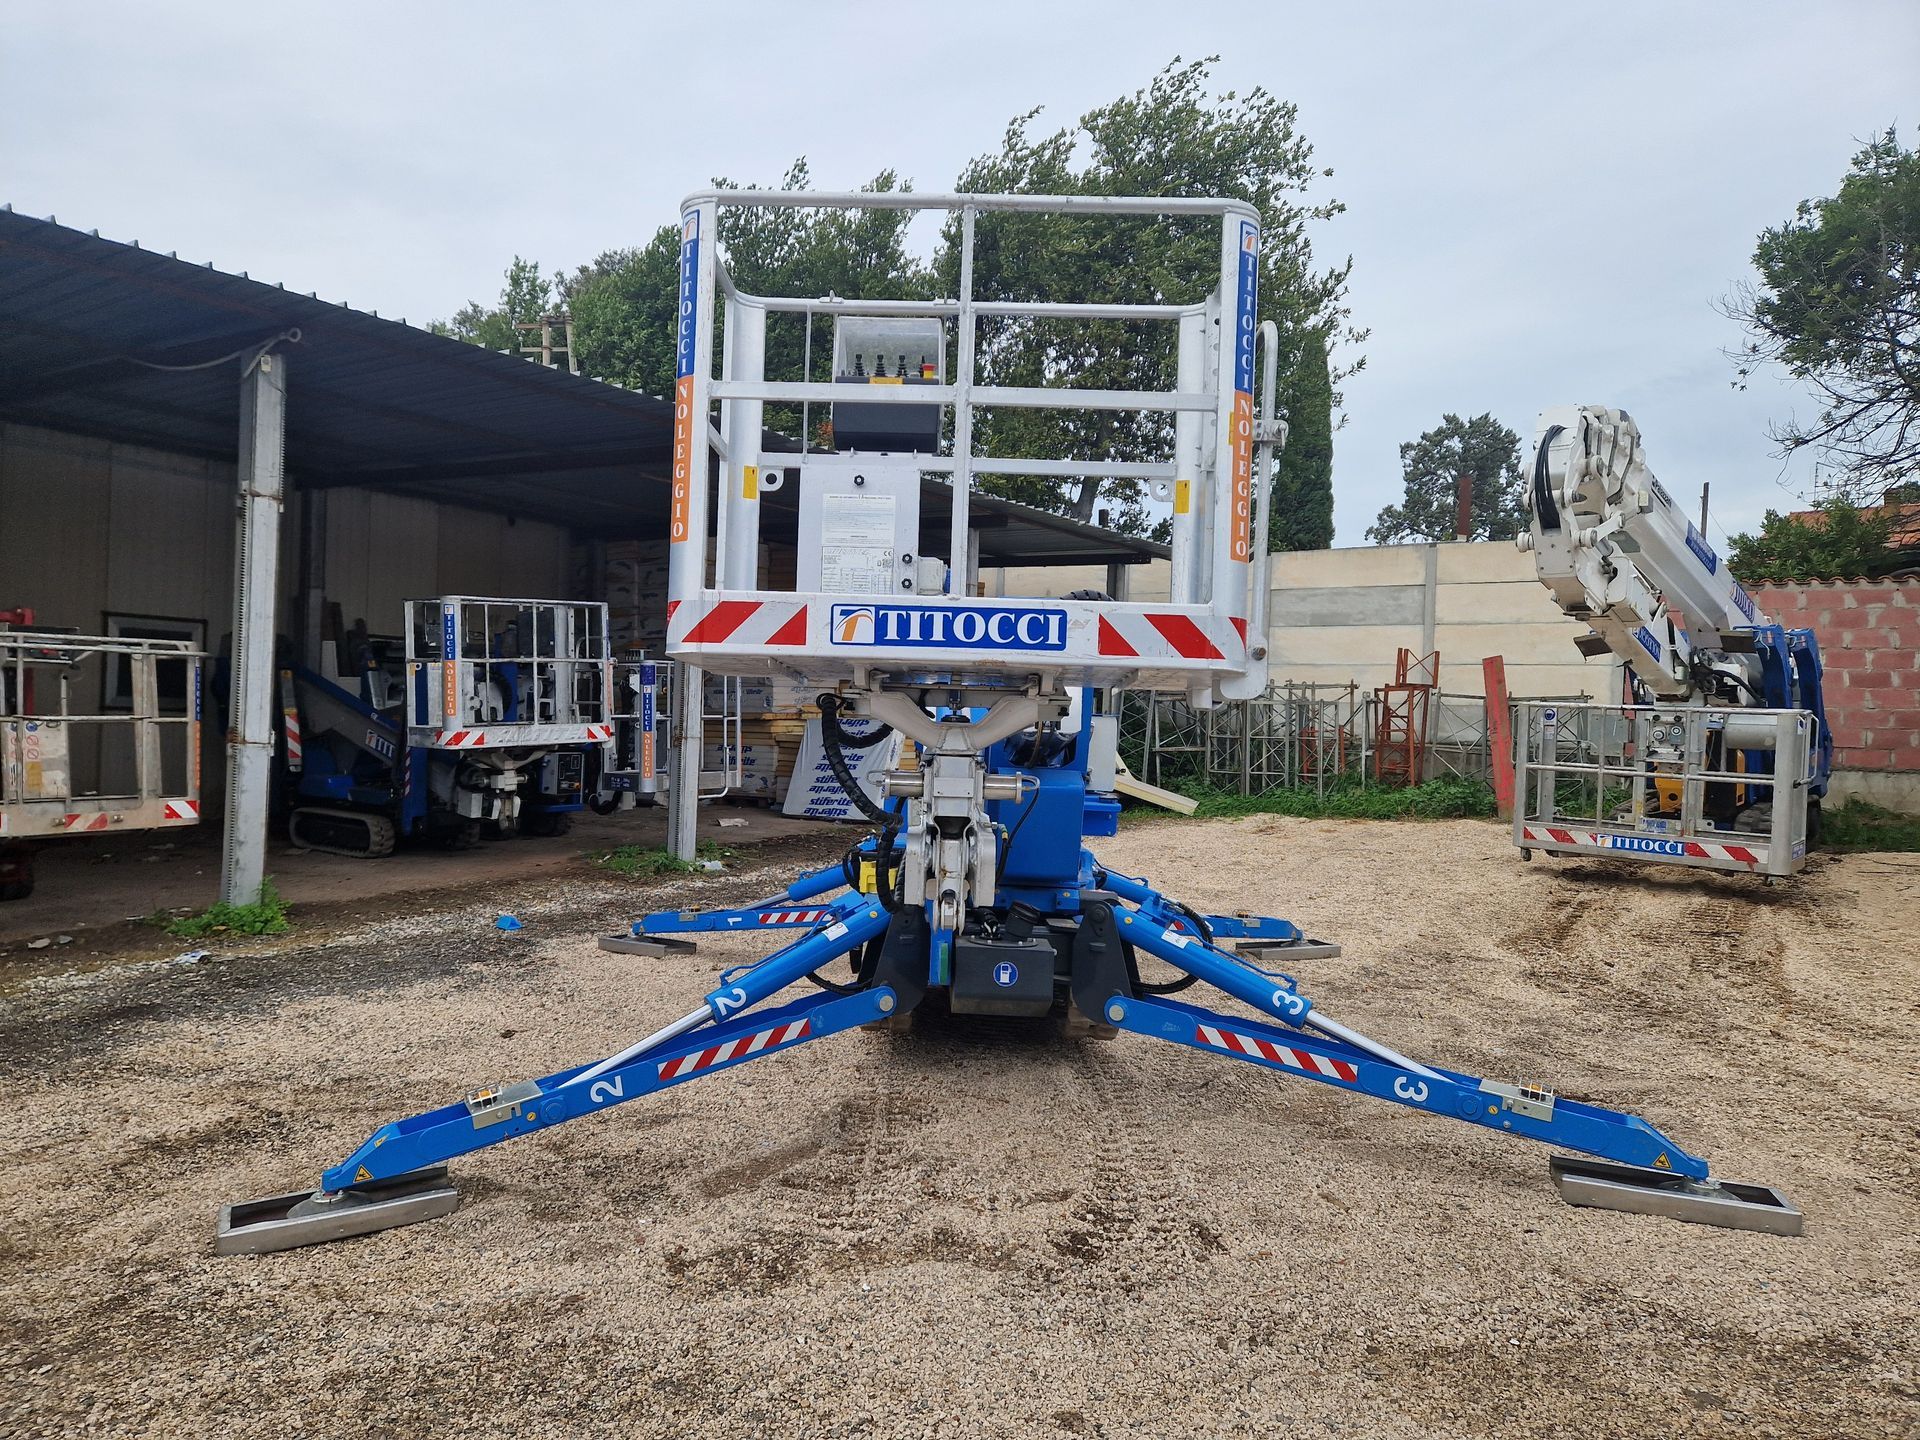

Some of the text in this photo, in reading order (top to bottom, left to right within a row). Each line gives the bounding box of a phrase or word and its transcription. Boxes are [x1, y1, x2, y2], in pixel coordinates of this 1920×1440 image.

[673, 242, 694, 537] TITOCCI NOLEGGIO
[1235, 255, 1255, 556] TITOCCI NOLEGGIO
[445, 614, 454, 659] TITOCCI
[879, 609, 1063, 646] TITOCCI
[804, 808, 849, 816] stiferite
[809, 797, 853, 806] stiferite
[1614, 836, 1683, 854] TITOCCI
[715, 987, 747, 1016] 2
[1272, 989, 1304, 1016] 3
[590, 1075, 624, 1103] 2
[1394, 1076, 1430, 1102] 3
